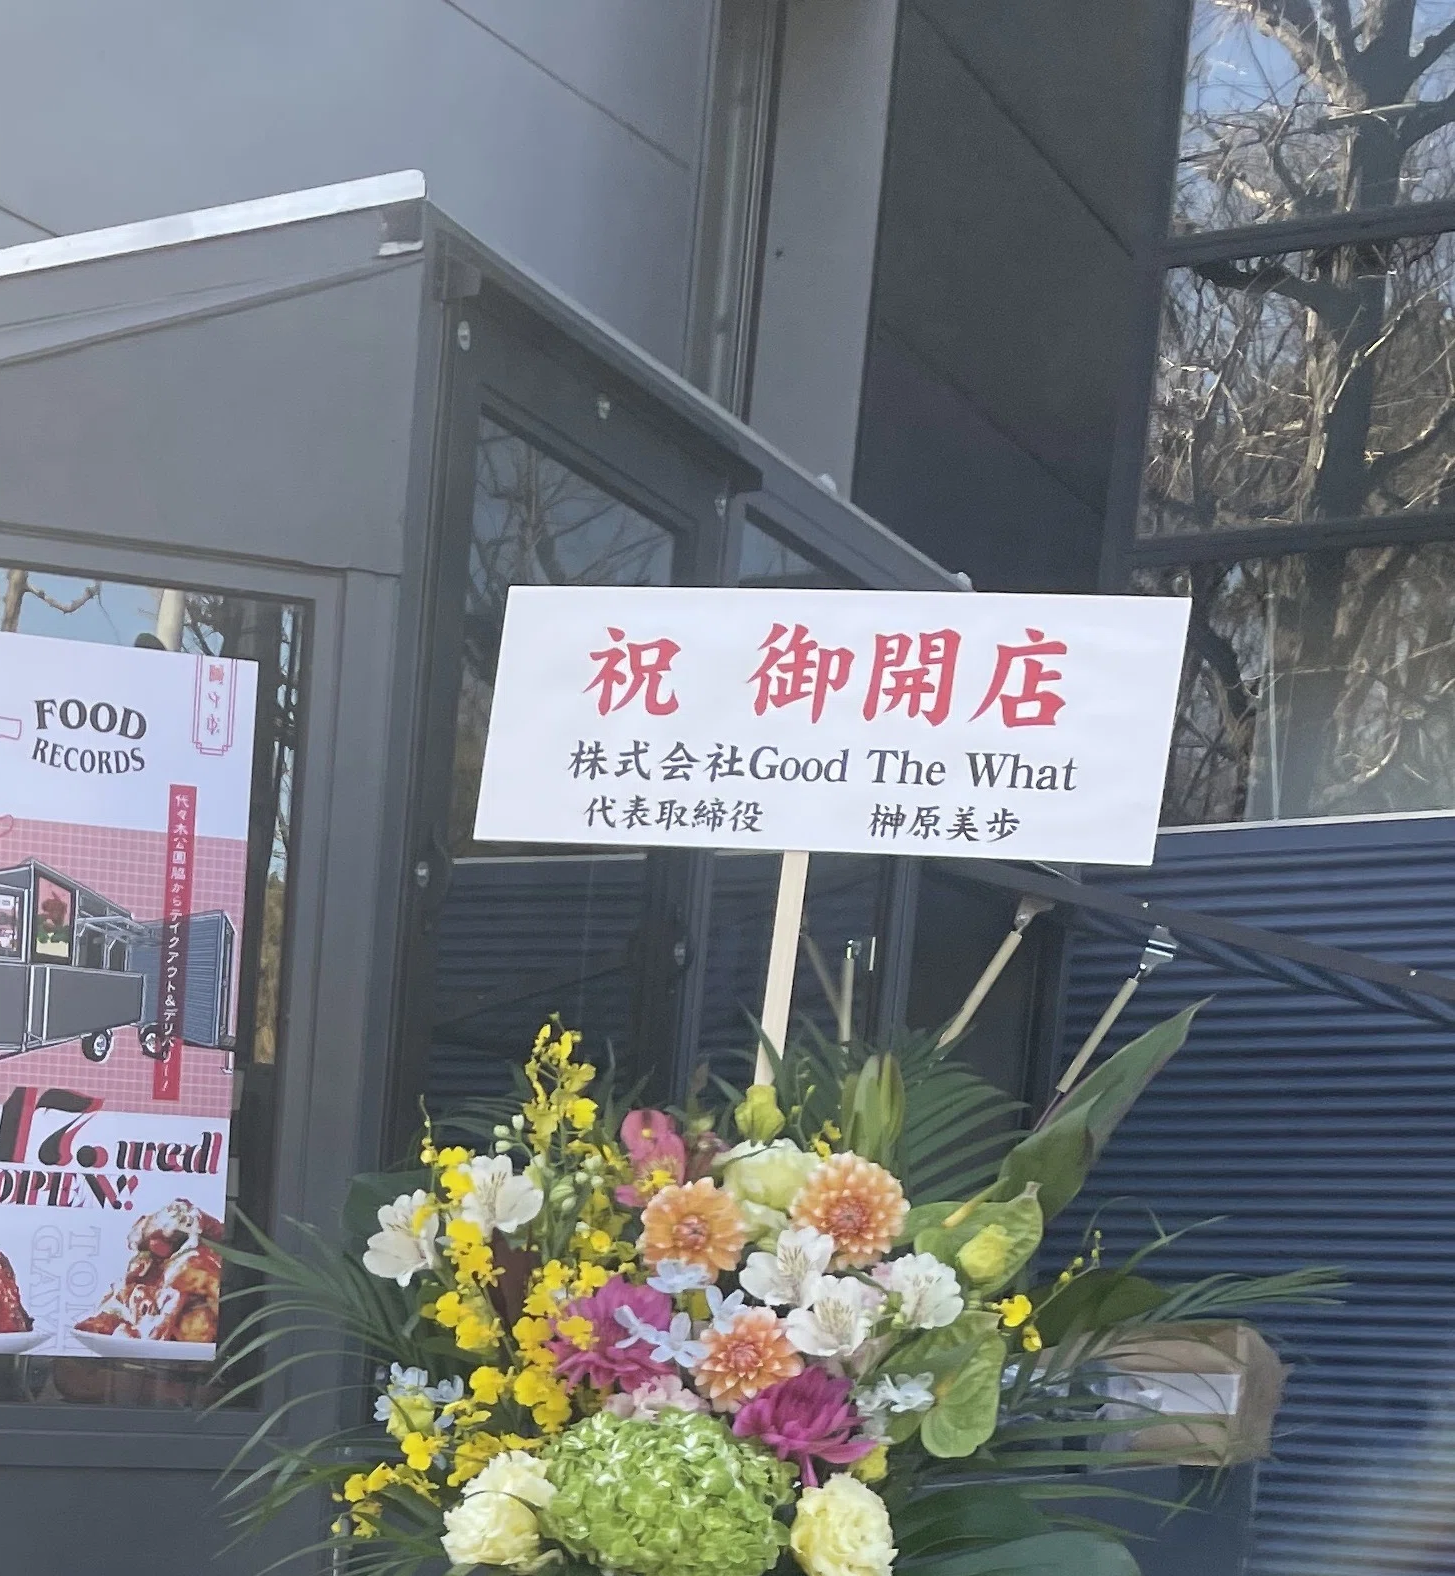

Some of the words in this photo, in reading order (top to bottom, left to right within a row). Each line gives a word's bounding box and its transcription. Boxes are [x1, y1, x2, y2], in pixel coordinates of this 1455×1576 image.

[582, 626, 682, 718] 祝
[746, 622, 1068, 729] 御開店
[33, 698, 148, 740] FOOD
[30, 737, 146, 775] RECORDS
[866, 749, 946, 788] The
[966, 749, 1078, 792] What
[583, 797, 765, 834] 代表取締役
[867, 803, 1021, 844] 榊原美歩
